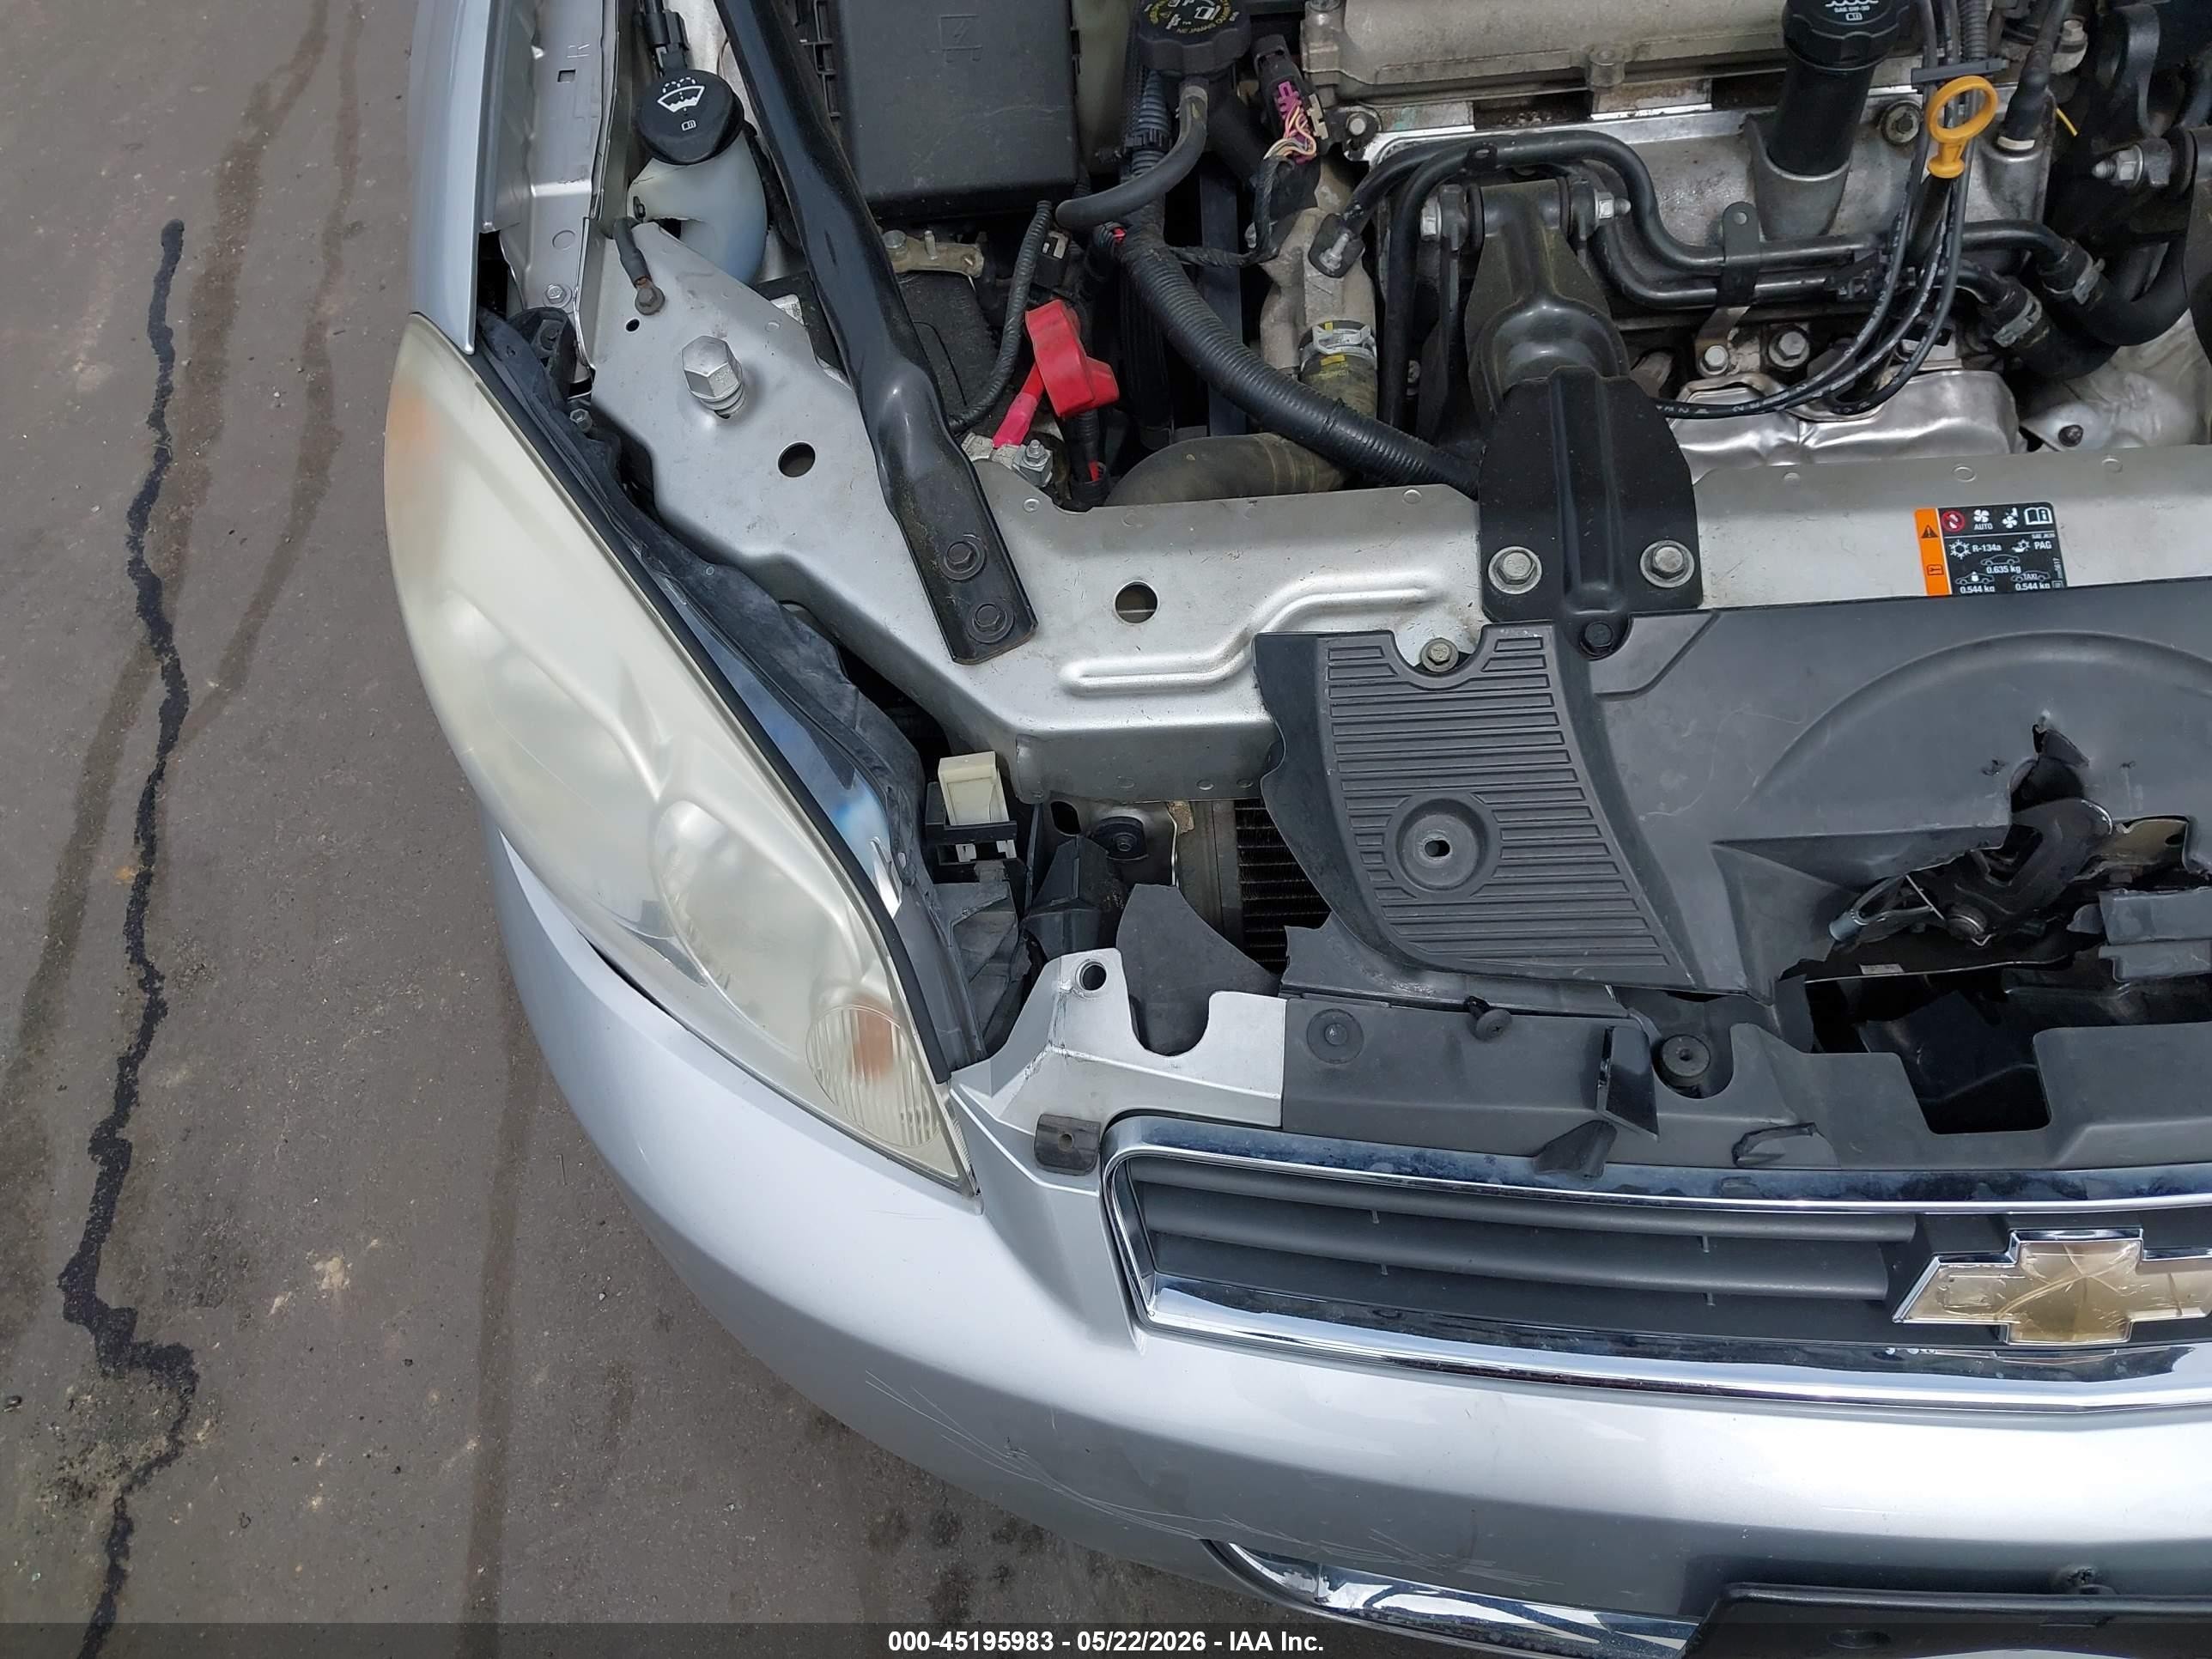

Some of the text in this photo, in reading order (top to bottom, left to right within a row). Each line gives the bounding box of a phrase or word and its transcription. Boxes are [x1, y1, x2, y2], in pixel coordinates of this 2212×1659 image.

[1972, 544, 2002, 552] R-134a
[2034, 541, 2052, 550] PAG
[1986, 565, 2021, 574] 0.635 kg
[1960, 586, 1983, 594] 0.544
[2015, 582, 2038, 591] 0.544
